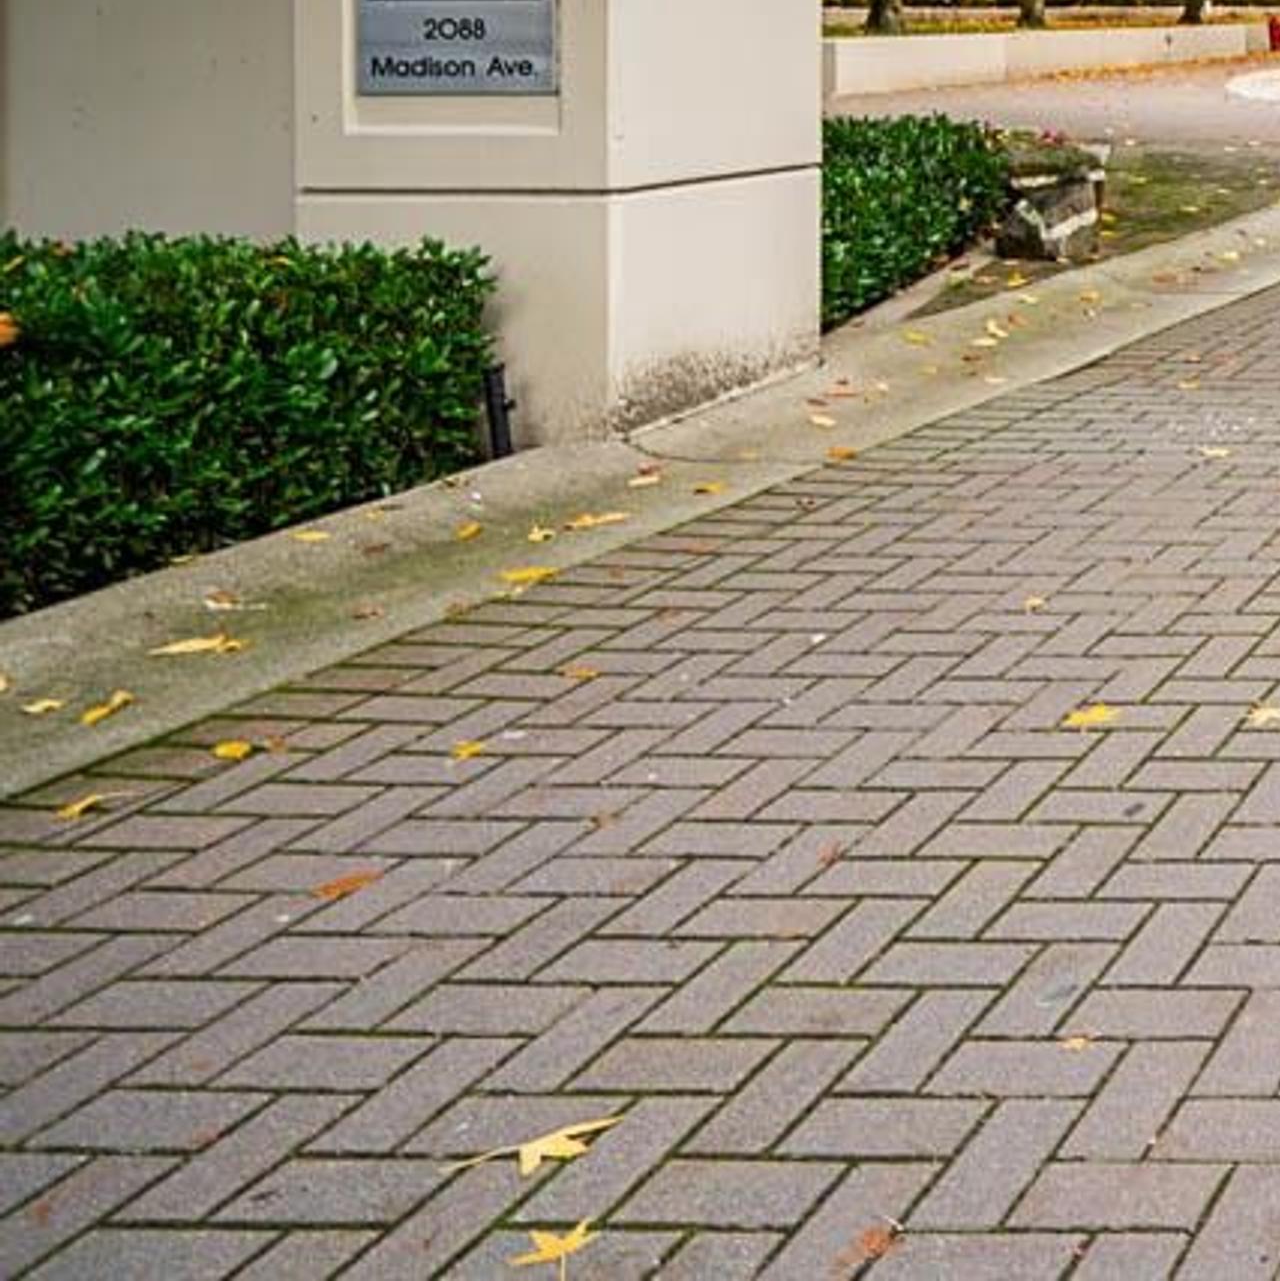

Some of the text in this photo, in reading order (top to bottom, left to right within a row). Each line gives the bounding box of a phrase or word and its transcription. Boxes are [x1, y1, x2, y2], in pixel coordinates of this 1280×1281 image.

[422, 17, 486, 40] 2088
[371, 56, 539, 79] Madison Ave.
